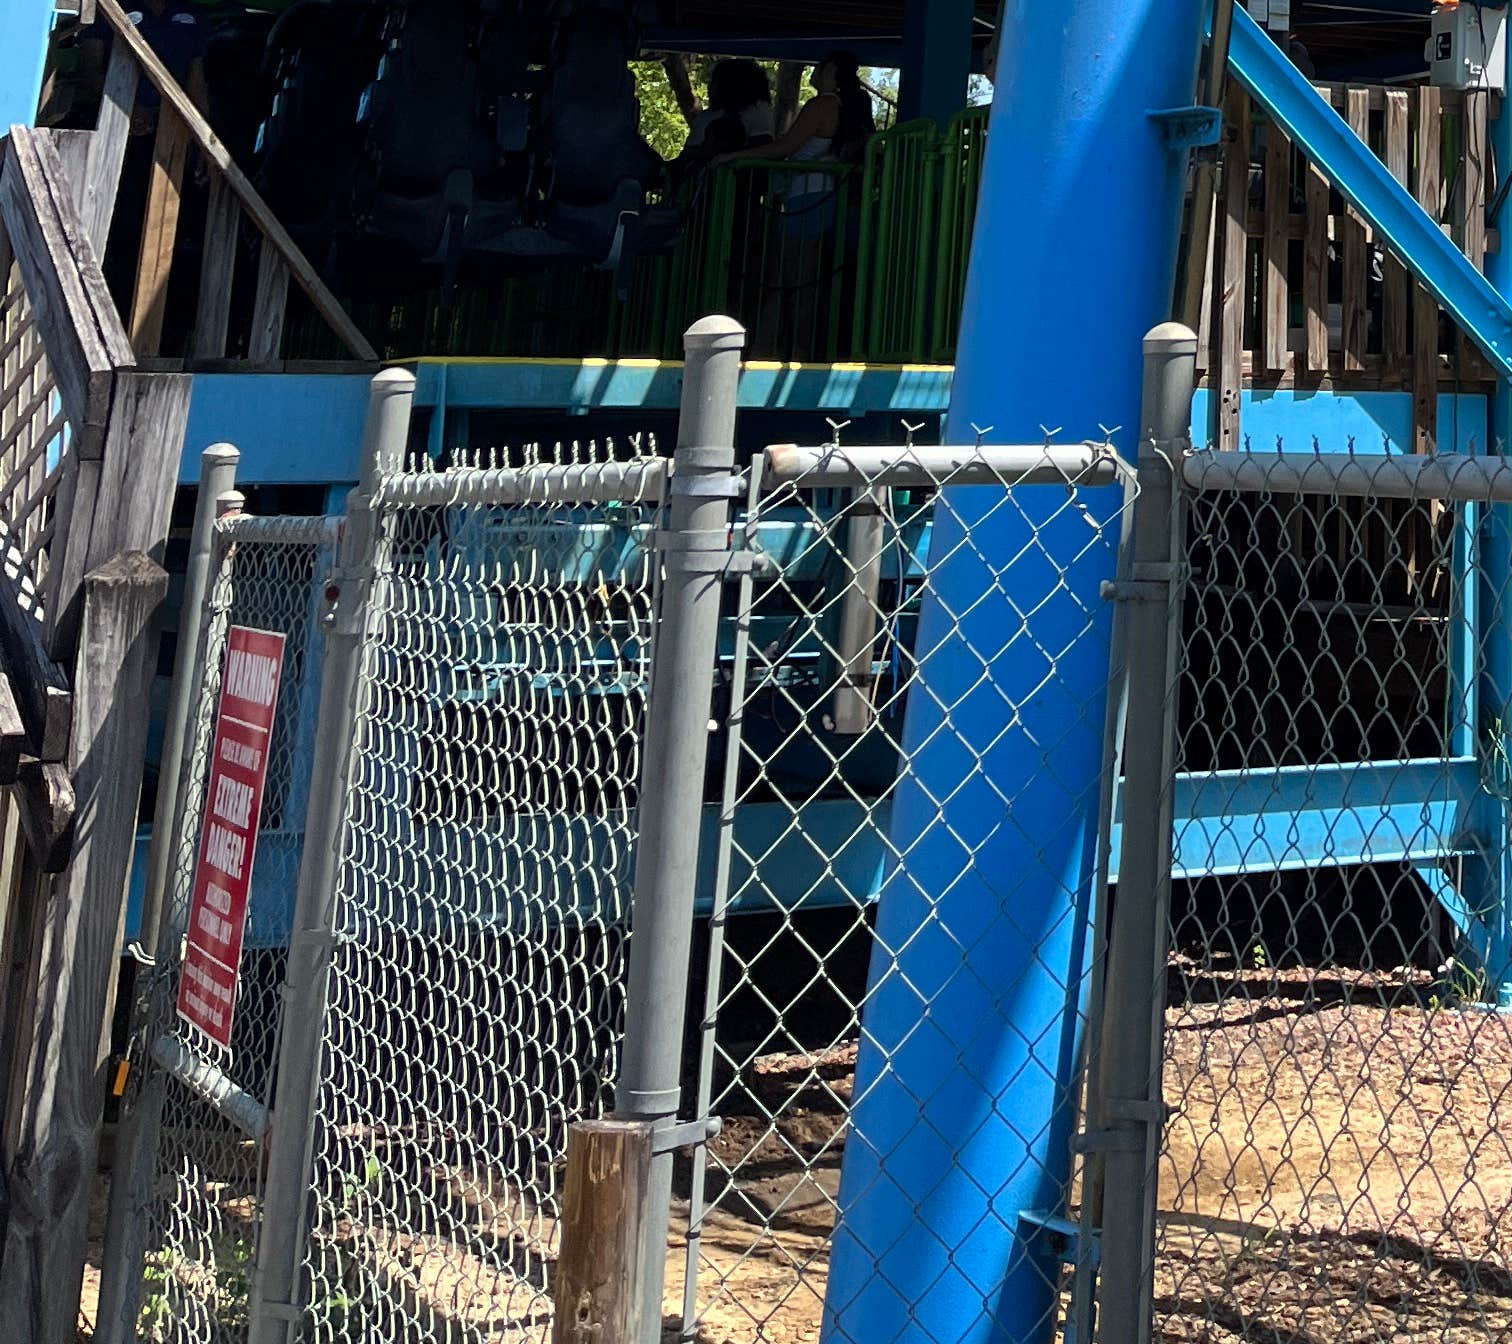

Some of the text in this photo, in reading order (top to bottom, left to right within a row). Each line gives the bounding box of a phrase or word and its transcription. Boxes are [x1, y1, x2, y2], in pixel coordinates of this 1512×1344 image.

[225, 649, 278, 709] WARNING
[212, 773, 255, 830] EXTREME
[205, 821, 247, 882] DANGER!
